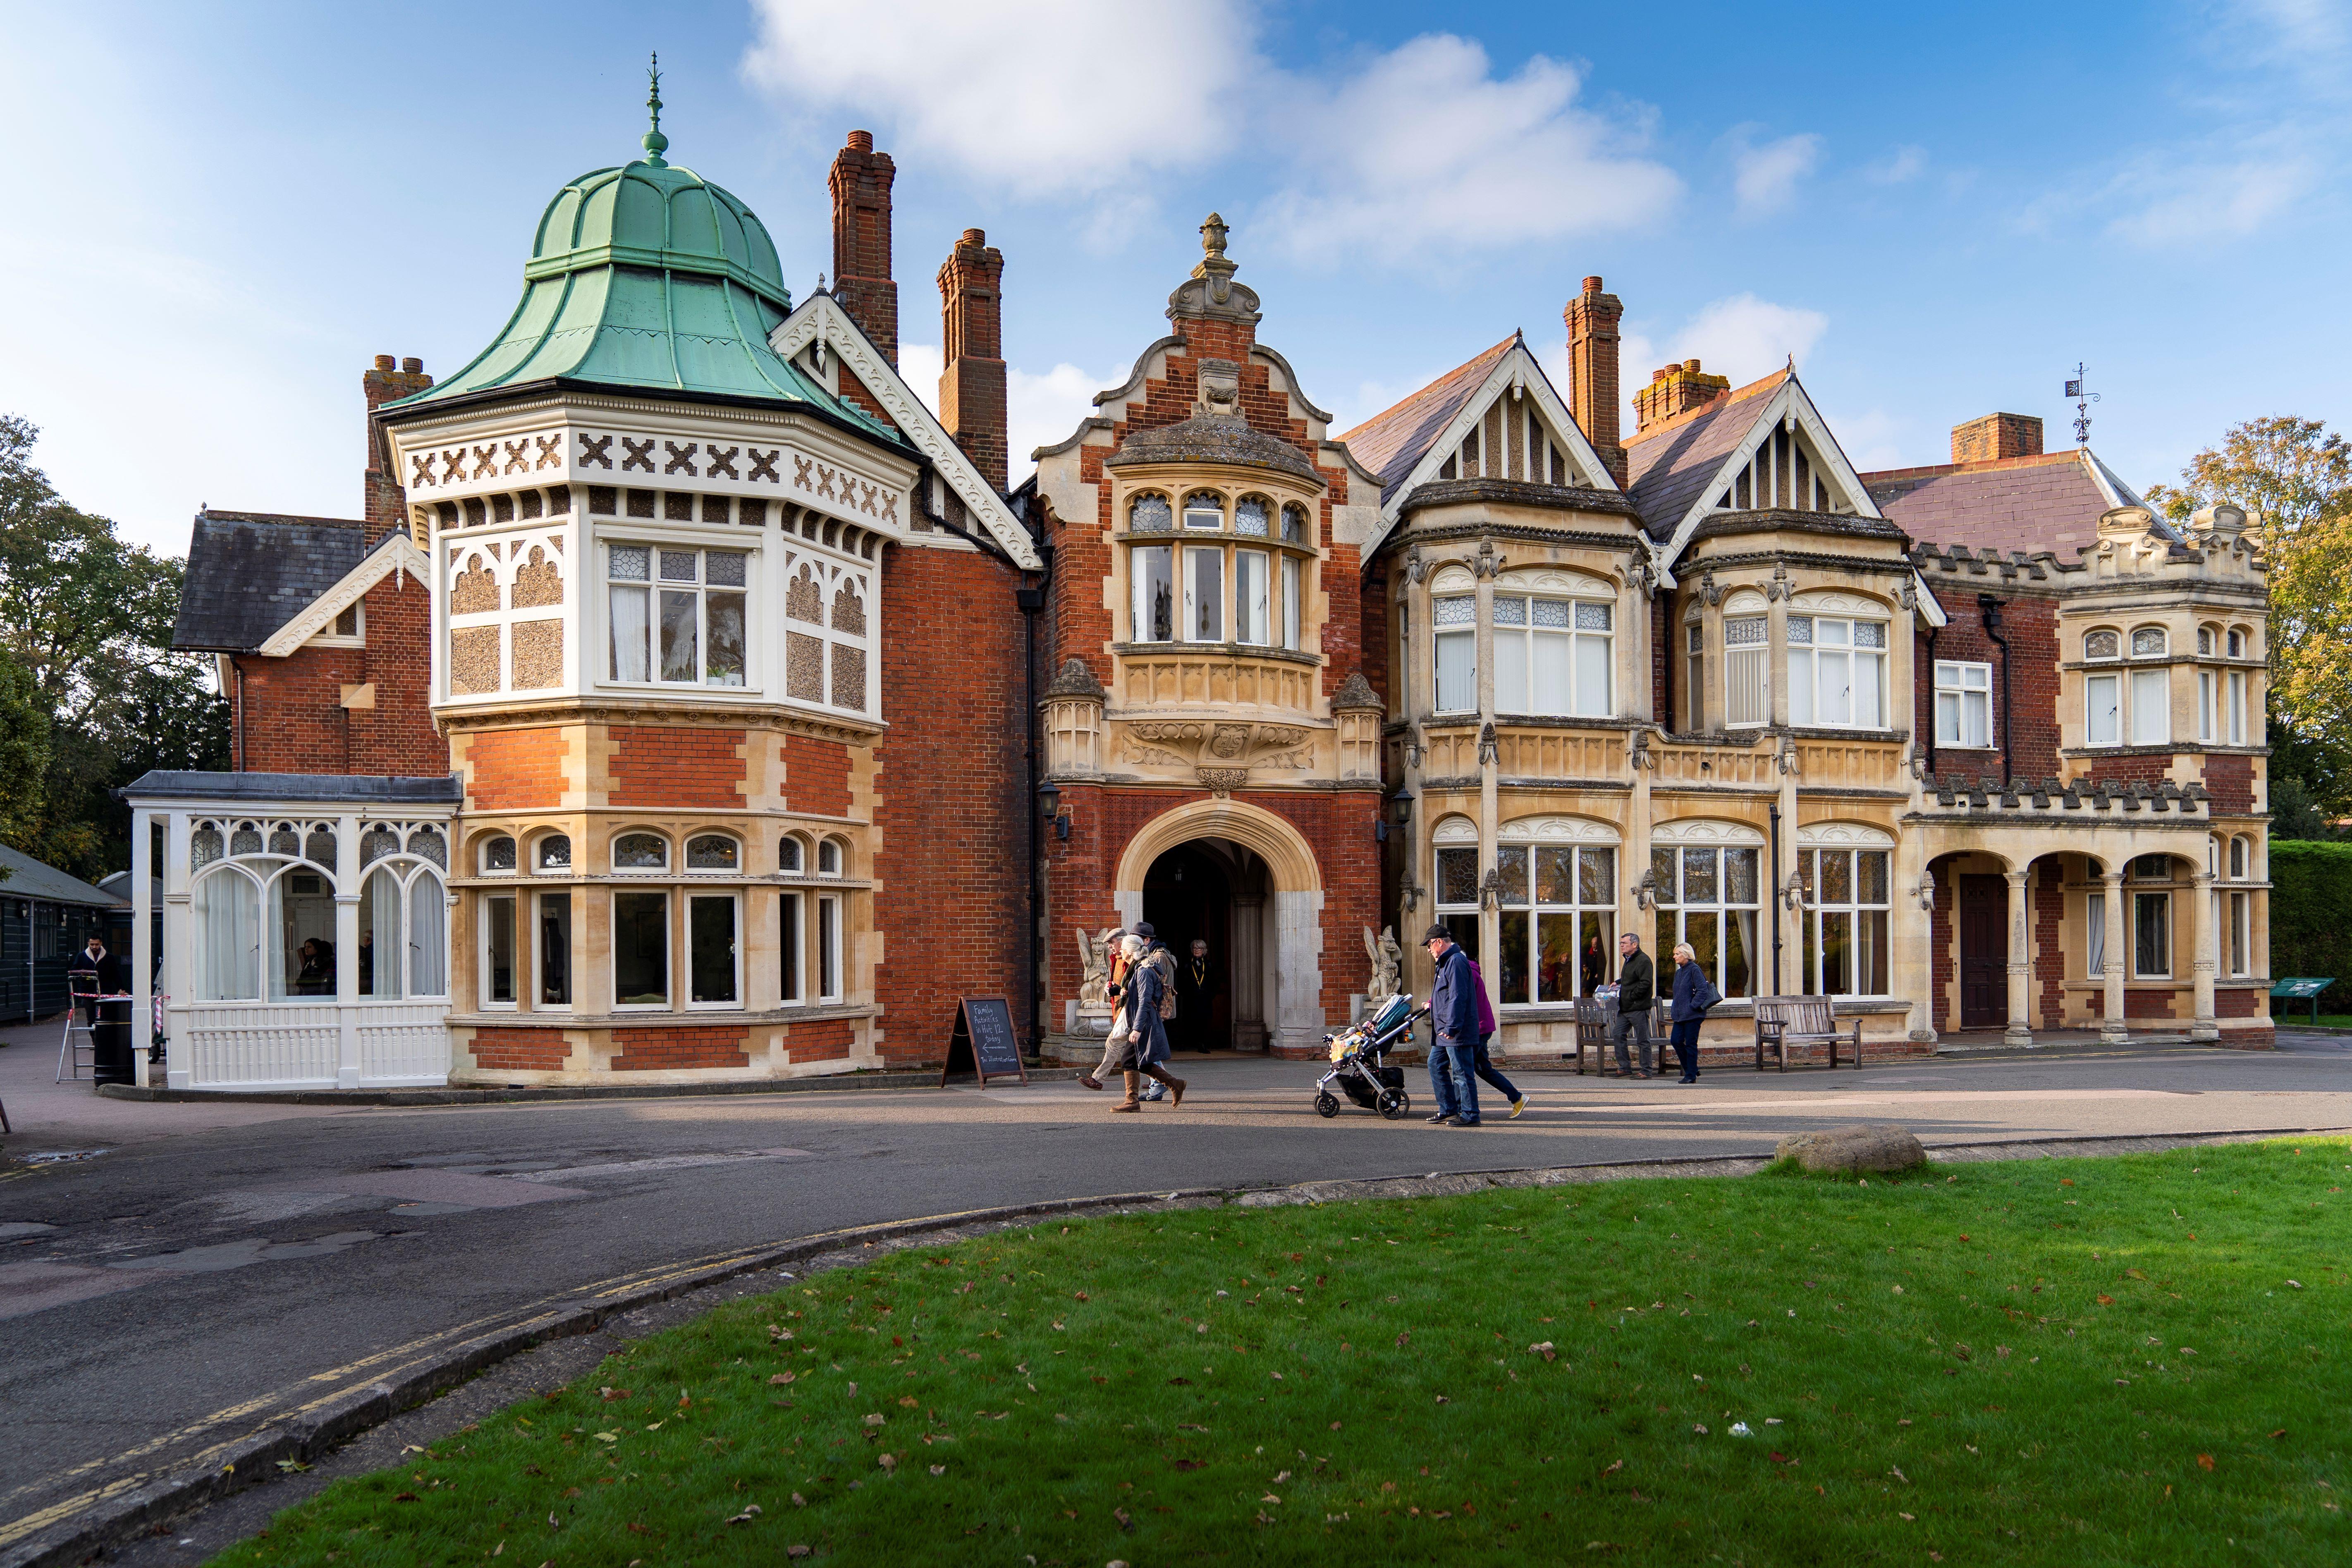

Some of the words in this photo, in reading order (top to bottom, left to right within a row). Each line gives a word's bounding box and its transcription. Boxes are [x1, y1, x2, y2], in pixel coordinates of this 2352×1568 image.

[974, 1004, 993, 1017] Family
[975, 1016, 998, 1024] Activities
[982, 1024, 992, 1033] Hut
[994, 1024, 1003, 1034] 12
[985, 1034, 1000, 1044] today
